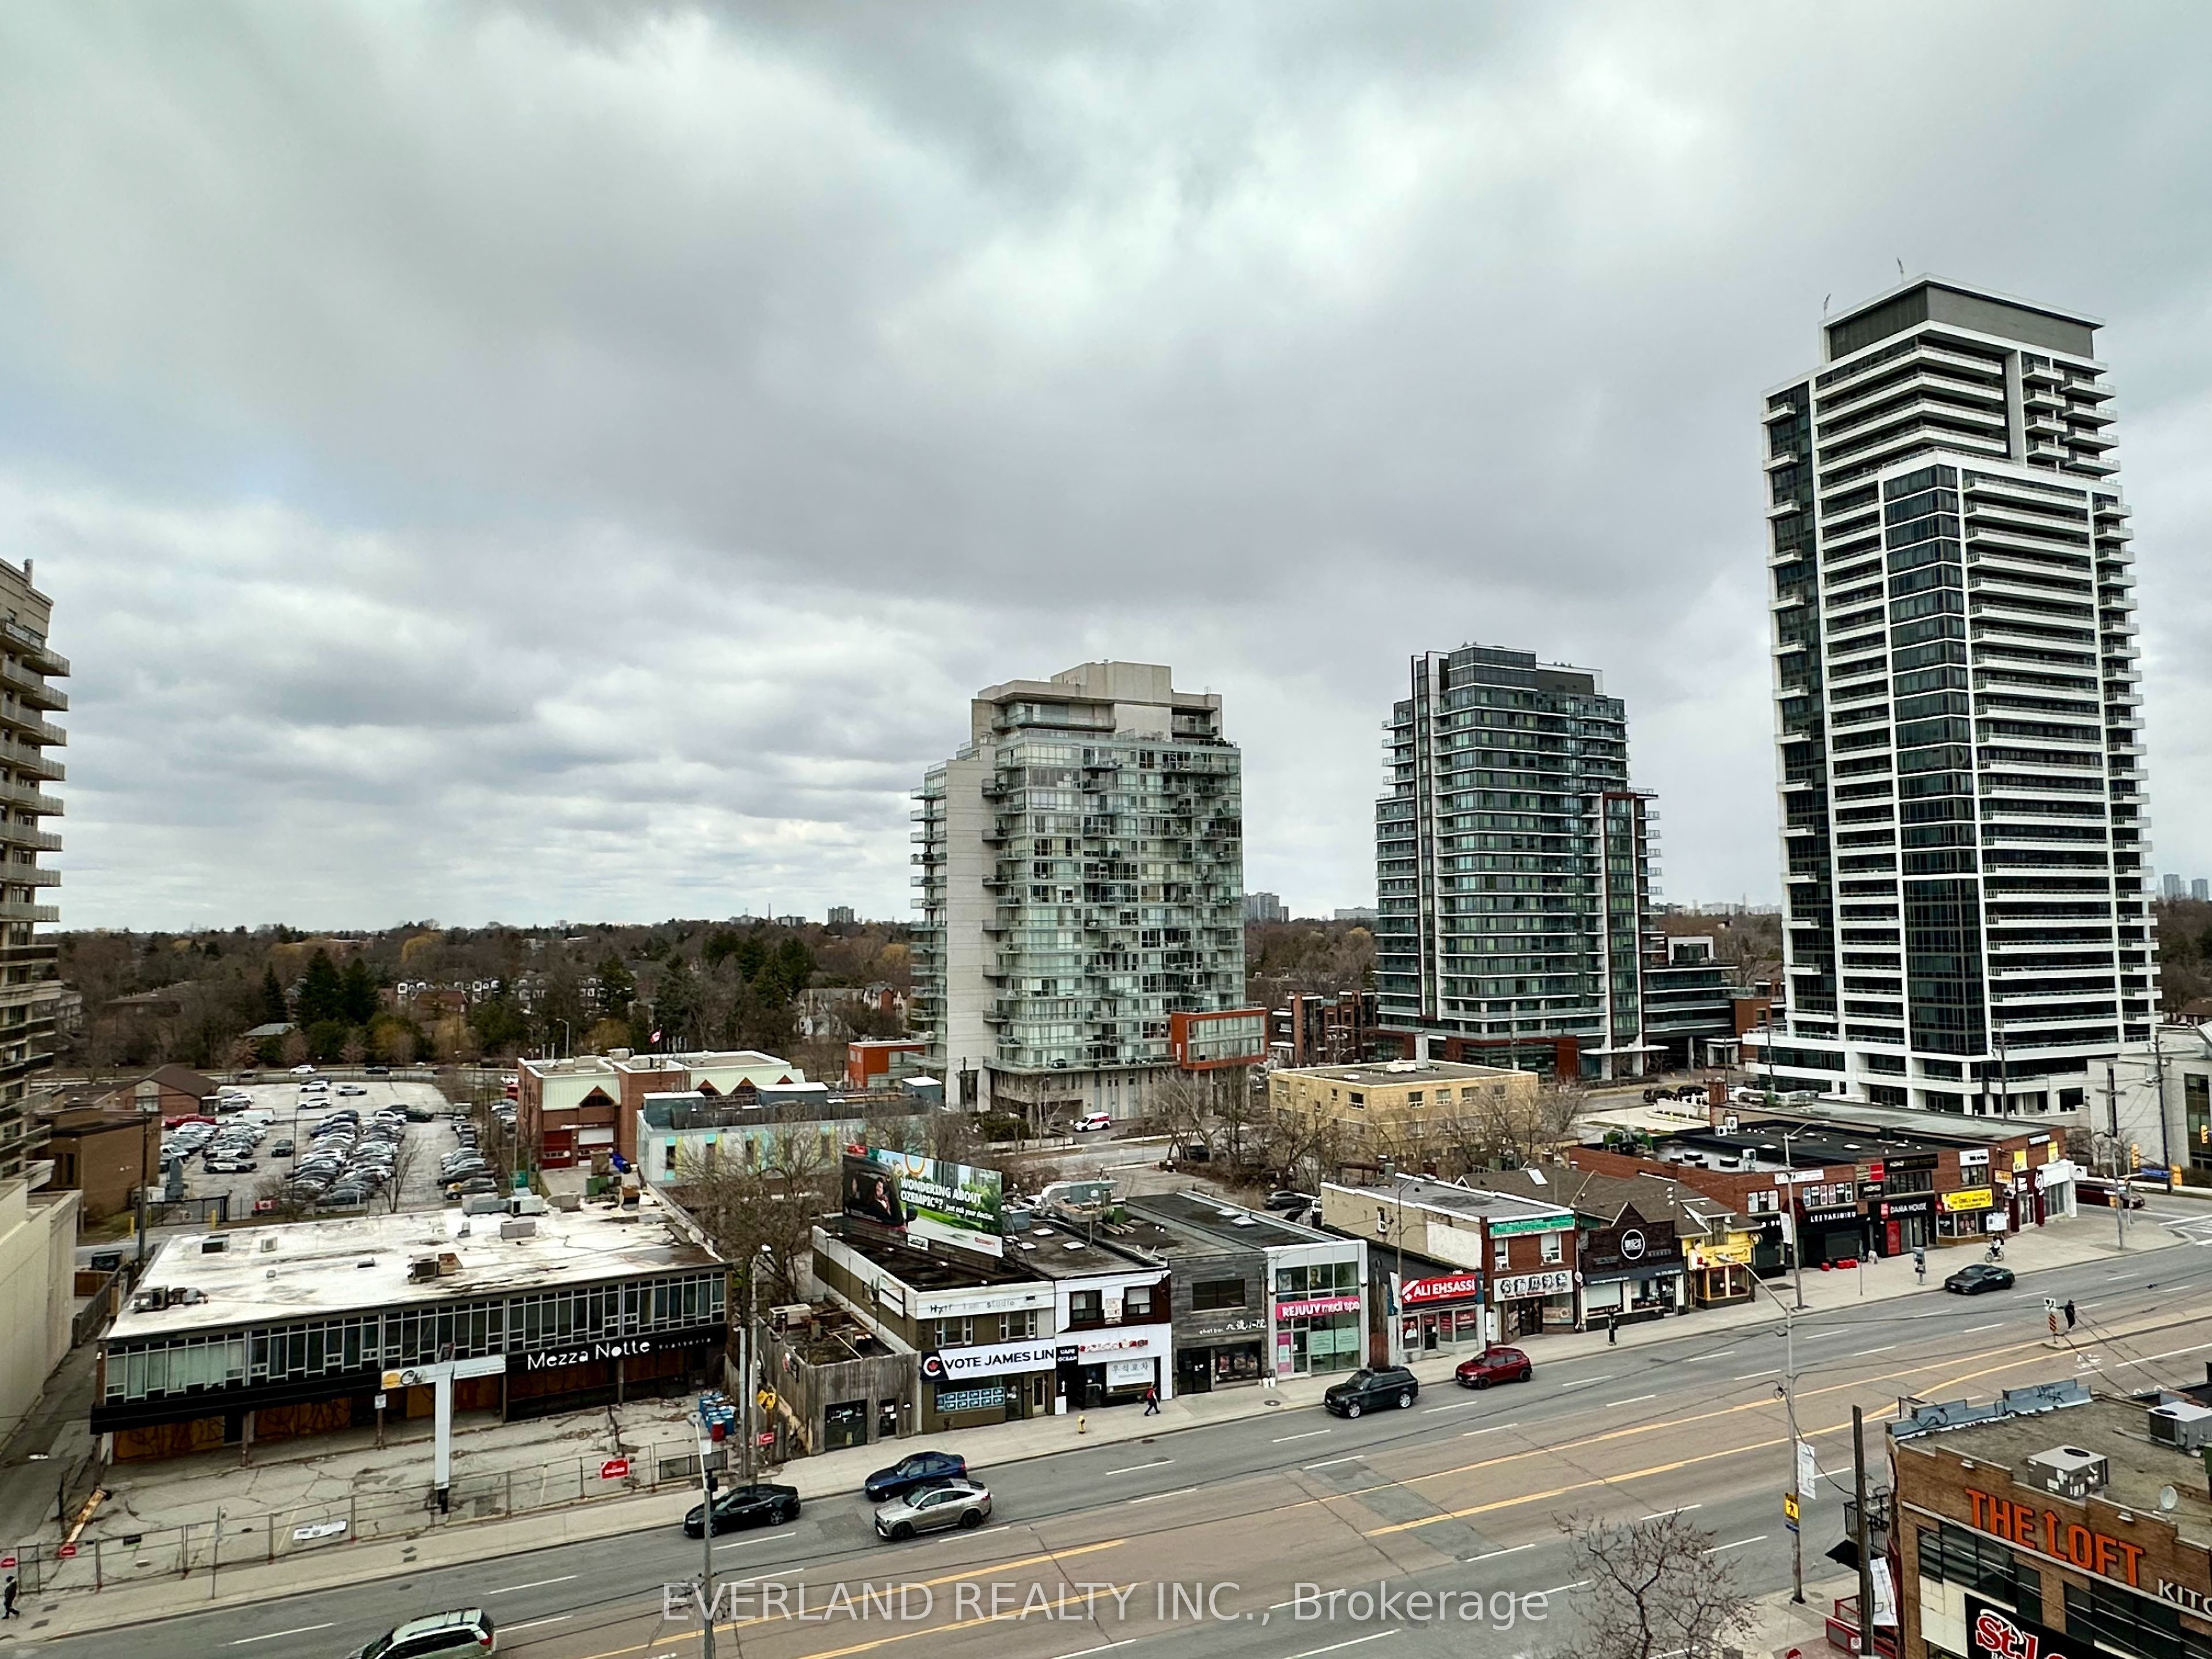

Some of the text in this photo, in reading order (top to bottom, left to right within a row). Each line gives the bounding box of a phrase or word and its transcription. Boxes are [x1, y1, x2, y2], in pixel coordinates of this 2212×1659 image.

[900, 1177, 982, 1205] WONDERING ABOUT
[1414, 1279, 1475, 1297] ALI EHSASSI
[528, 1351, 588, 1370] Mezza
[595, 1340, 651, 1360] Notte
[944, 1357, 981, 1370] VOTE
[984, 1351, 1031, 1366] JAMES
[1033, 1349, 1054, 1361] LIN
[1965, 1488, 2144, 1587] THE LOFT
